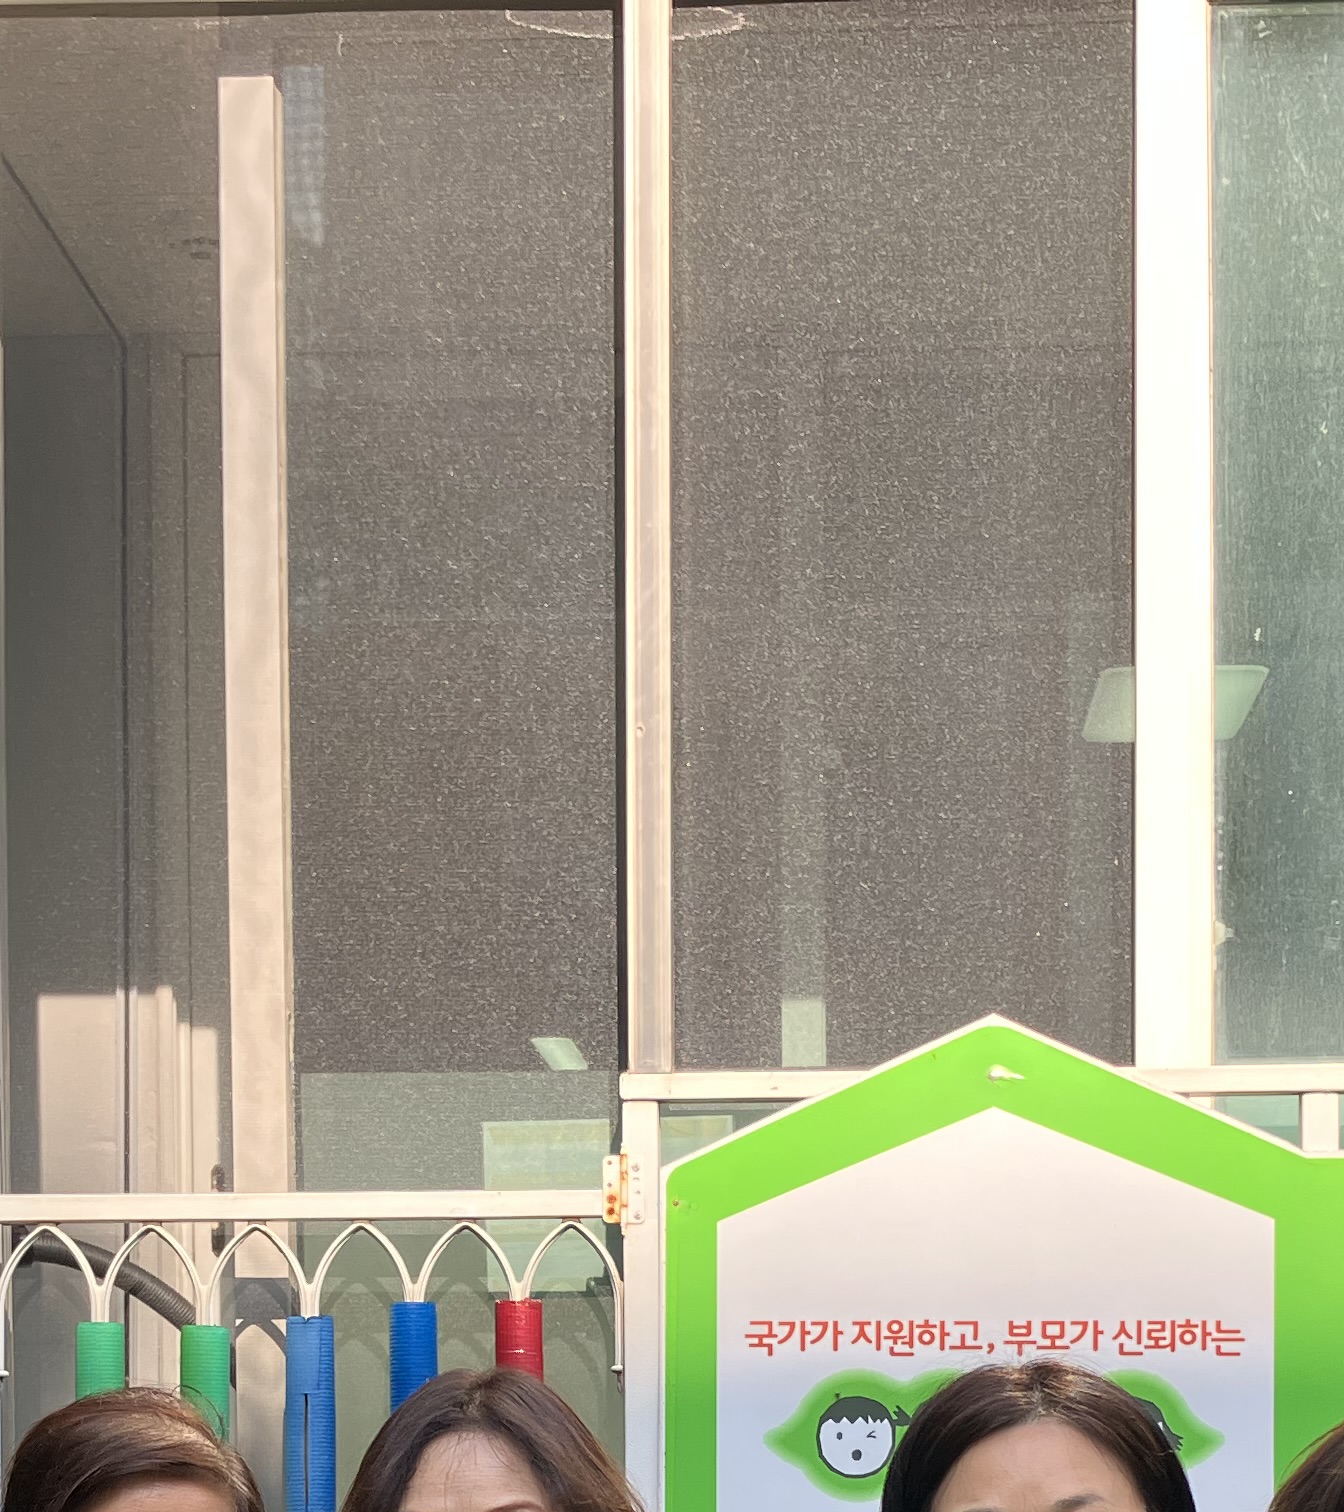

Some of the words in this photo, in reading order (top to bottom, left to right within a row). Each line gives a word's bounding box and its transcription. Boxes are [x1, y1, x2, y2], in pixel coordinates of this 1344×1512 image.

[743, 1319, 843, 1357] 국가가
[850, 1318, 996, 1357] 지원하고,
[1002, 1319, 1105, 1357] 부모가
[1110, 1318, 1246, 1357] 신뢰하는
